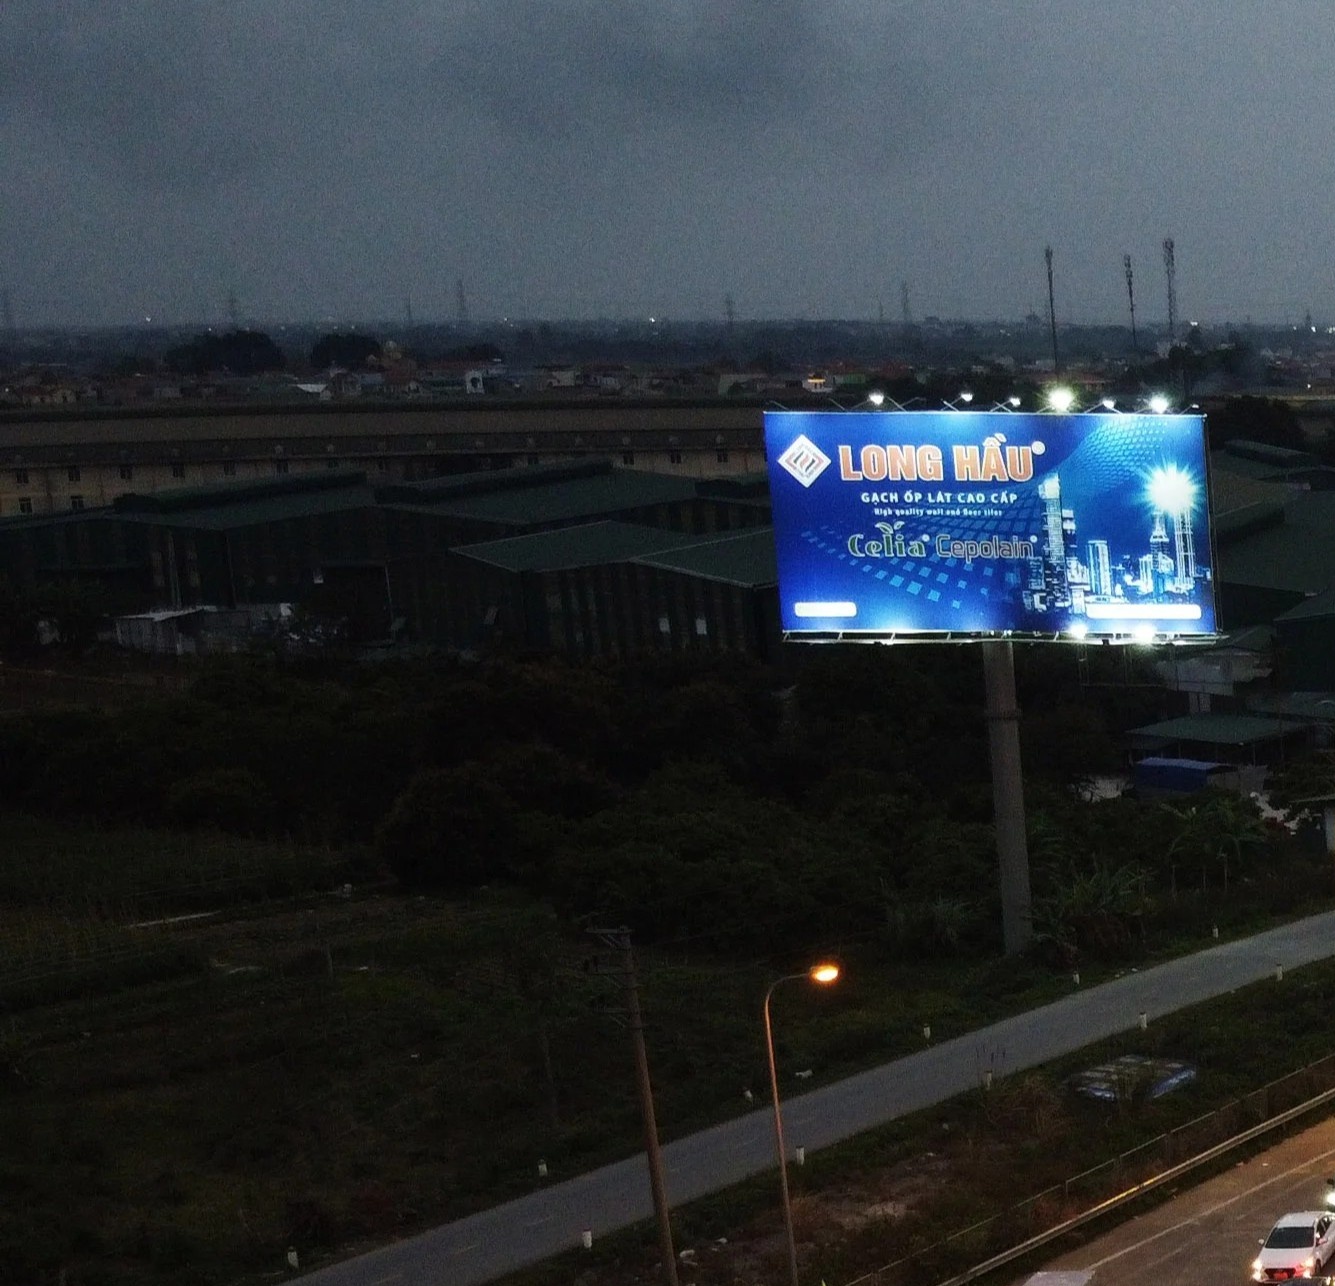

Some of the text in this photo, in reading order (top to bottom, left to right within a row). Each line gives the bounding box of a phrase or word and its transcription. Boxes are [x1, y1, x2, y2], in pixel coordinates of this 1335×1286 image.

[838, 433, 1033, 482] LONG HẦU
[861, 489, 1018, 506] GẠCH ỐP LÁT CAO CẤP
[874, 508, 893, 517] High
[895, 508, 924, 517] quality
[847, 532, 1034, 564] Celia Cepolain
